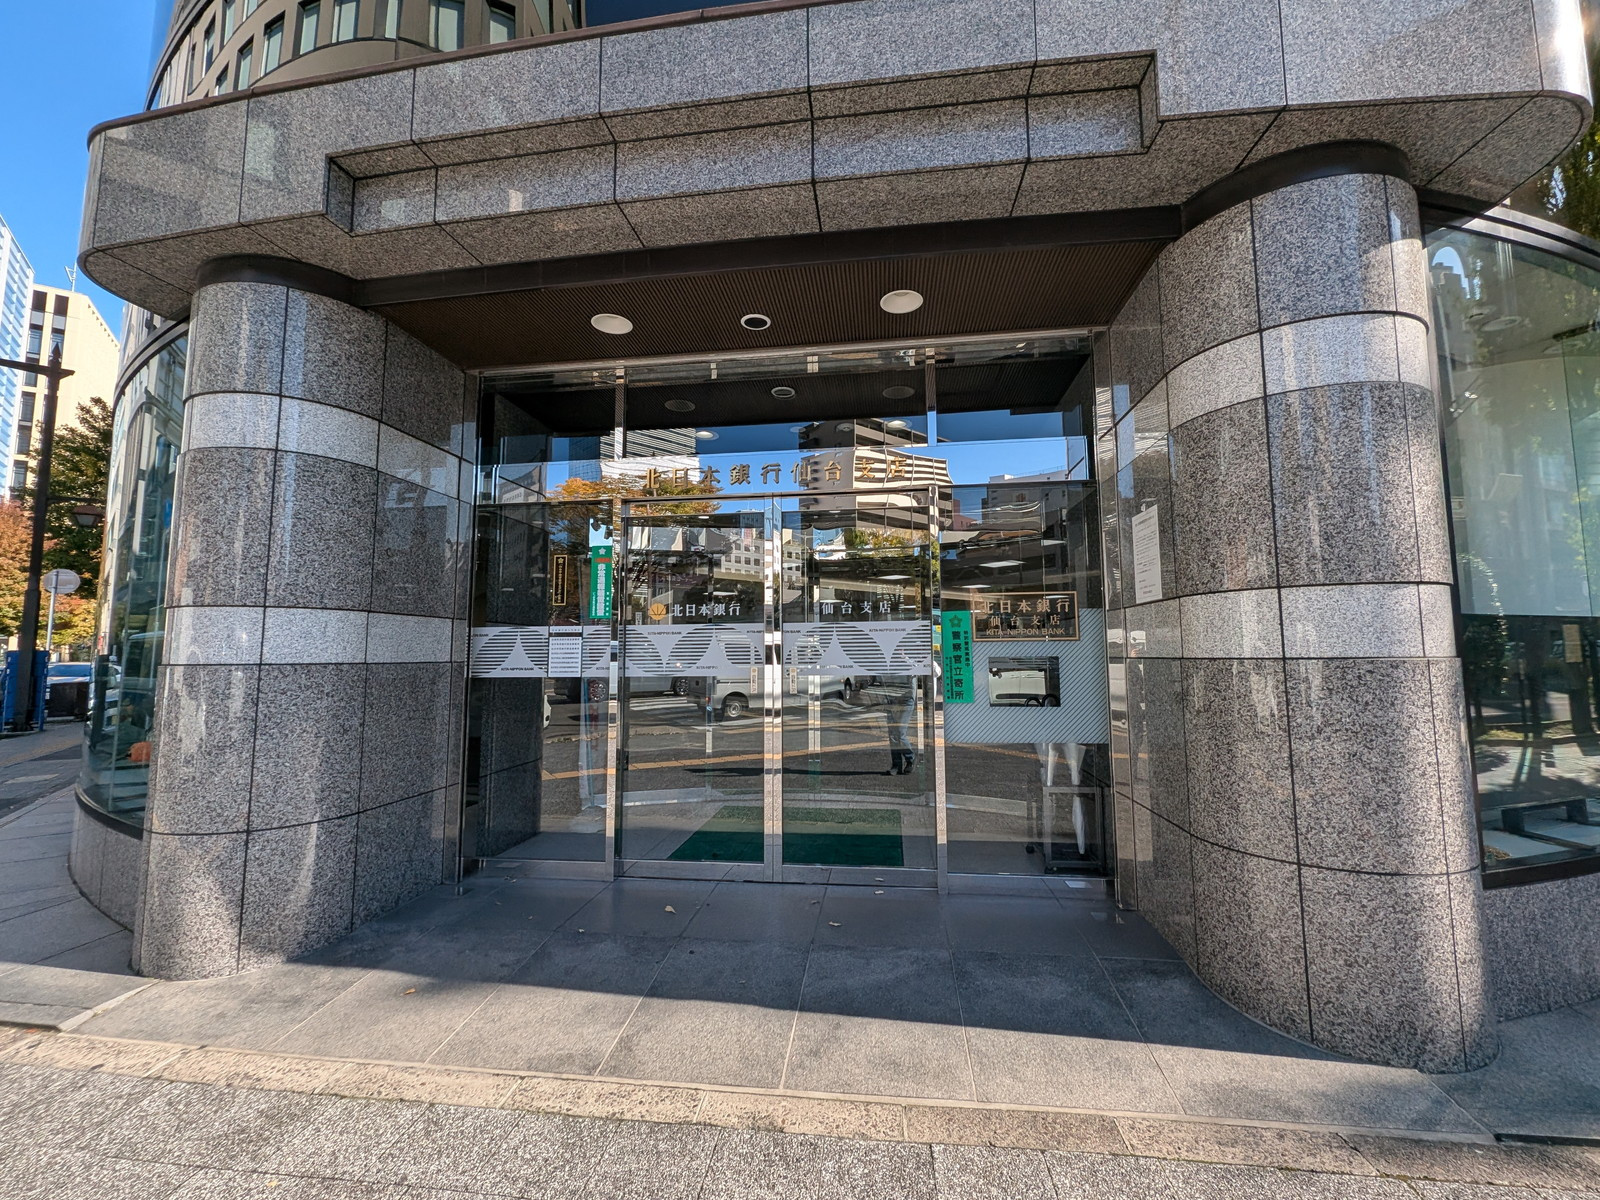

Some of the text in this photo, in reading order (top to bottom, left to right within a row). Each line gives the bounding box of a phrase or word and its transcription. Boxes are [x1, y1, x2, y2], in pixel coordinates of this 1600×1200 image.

[643, 456, 907, 489] 北日本銀行仙台支店
[671, 600, 892, 617] 北日本銀行 仙台支店
[984, 598, 1070, 614] 北日本銀行
[989, 614, 1061, 626] 仙台支店
[952, 630, 964, 700] 警察官立寄所
